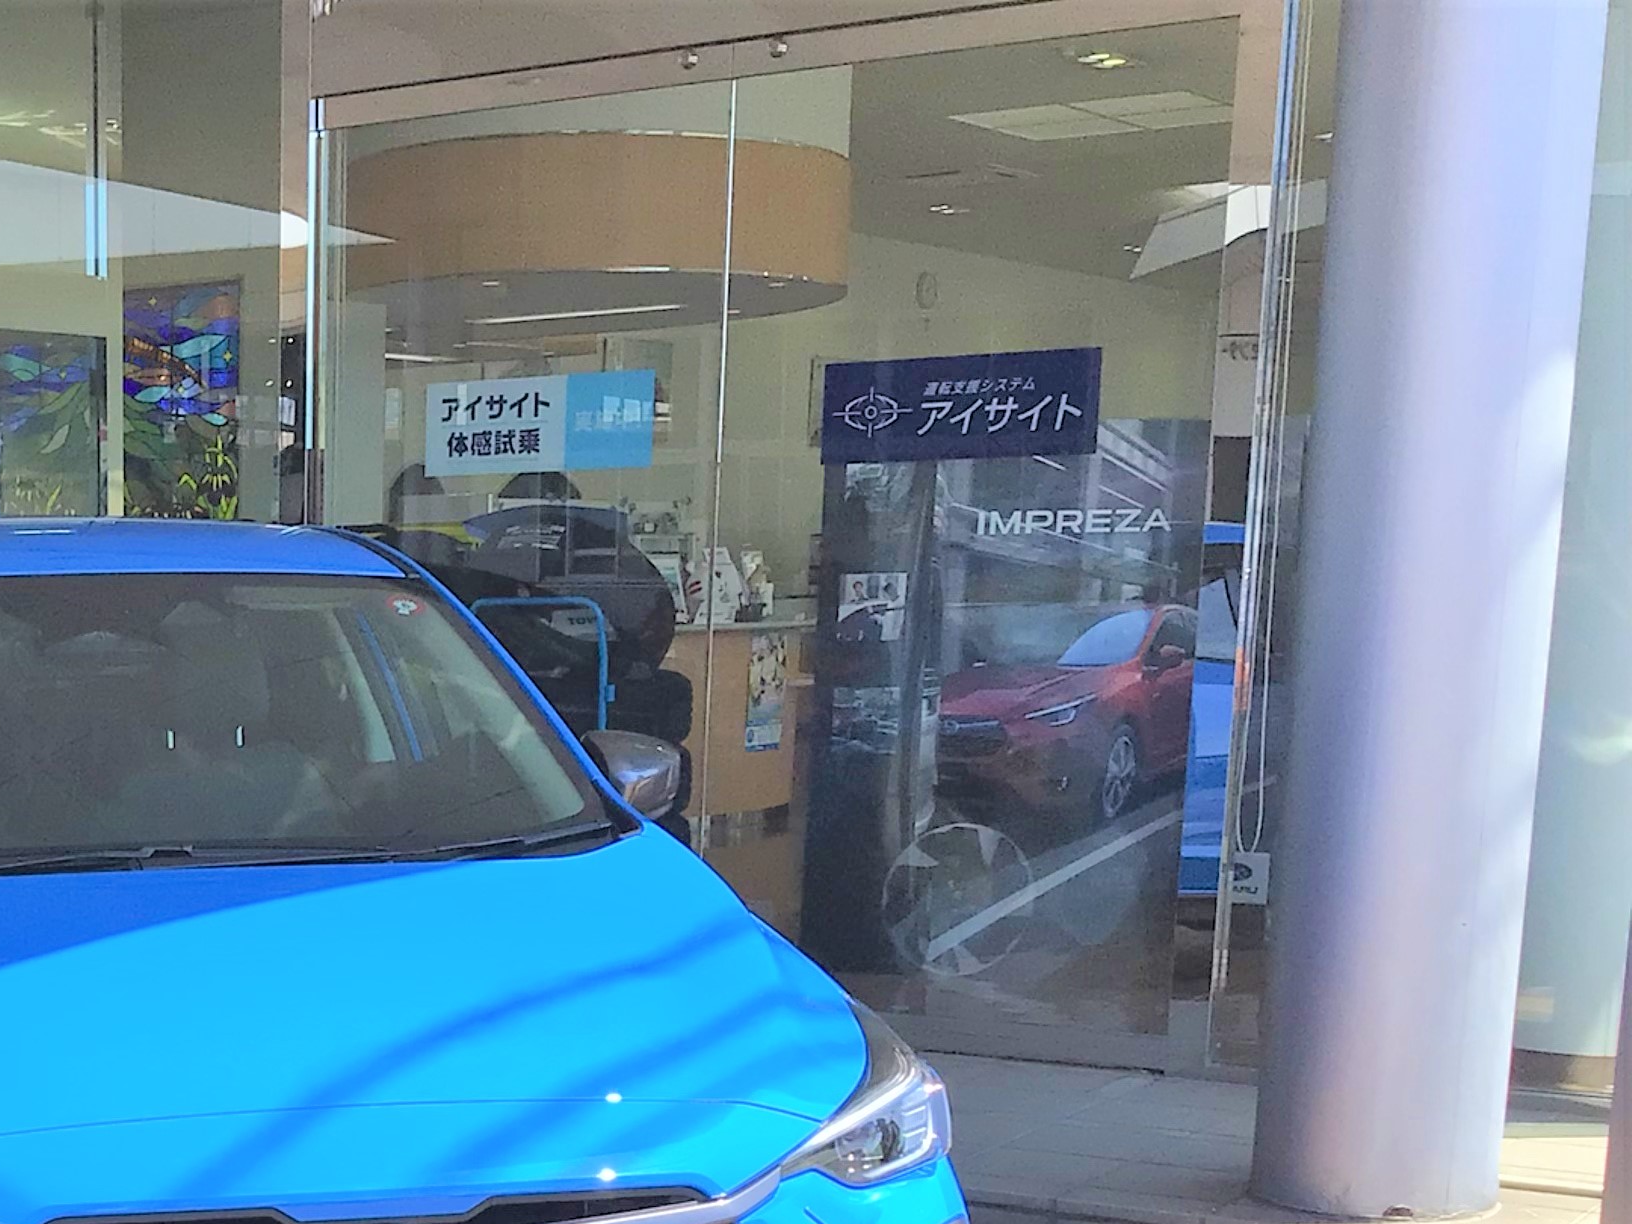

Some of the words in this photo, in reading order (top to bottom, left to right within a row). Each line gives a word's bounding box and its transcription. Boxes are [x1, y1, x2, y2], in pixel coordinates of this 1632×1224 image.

[922, 376, 1036, 396] 運転支援システム
[441, 391, 550, 423] アイサイト
[916, 393, 1083, 436] アイサイト
[447, 428, 541, 458] 体感試乗
[976, 507, 1172, 536] IMPREZA
